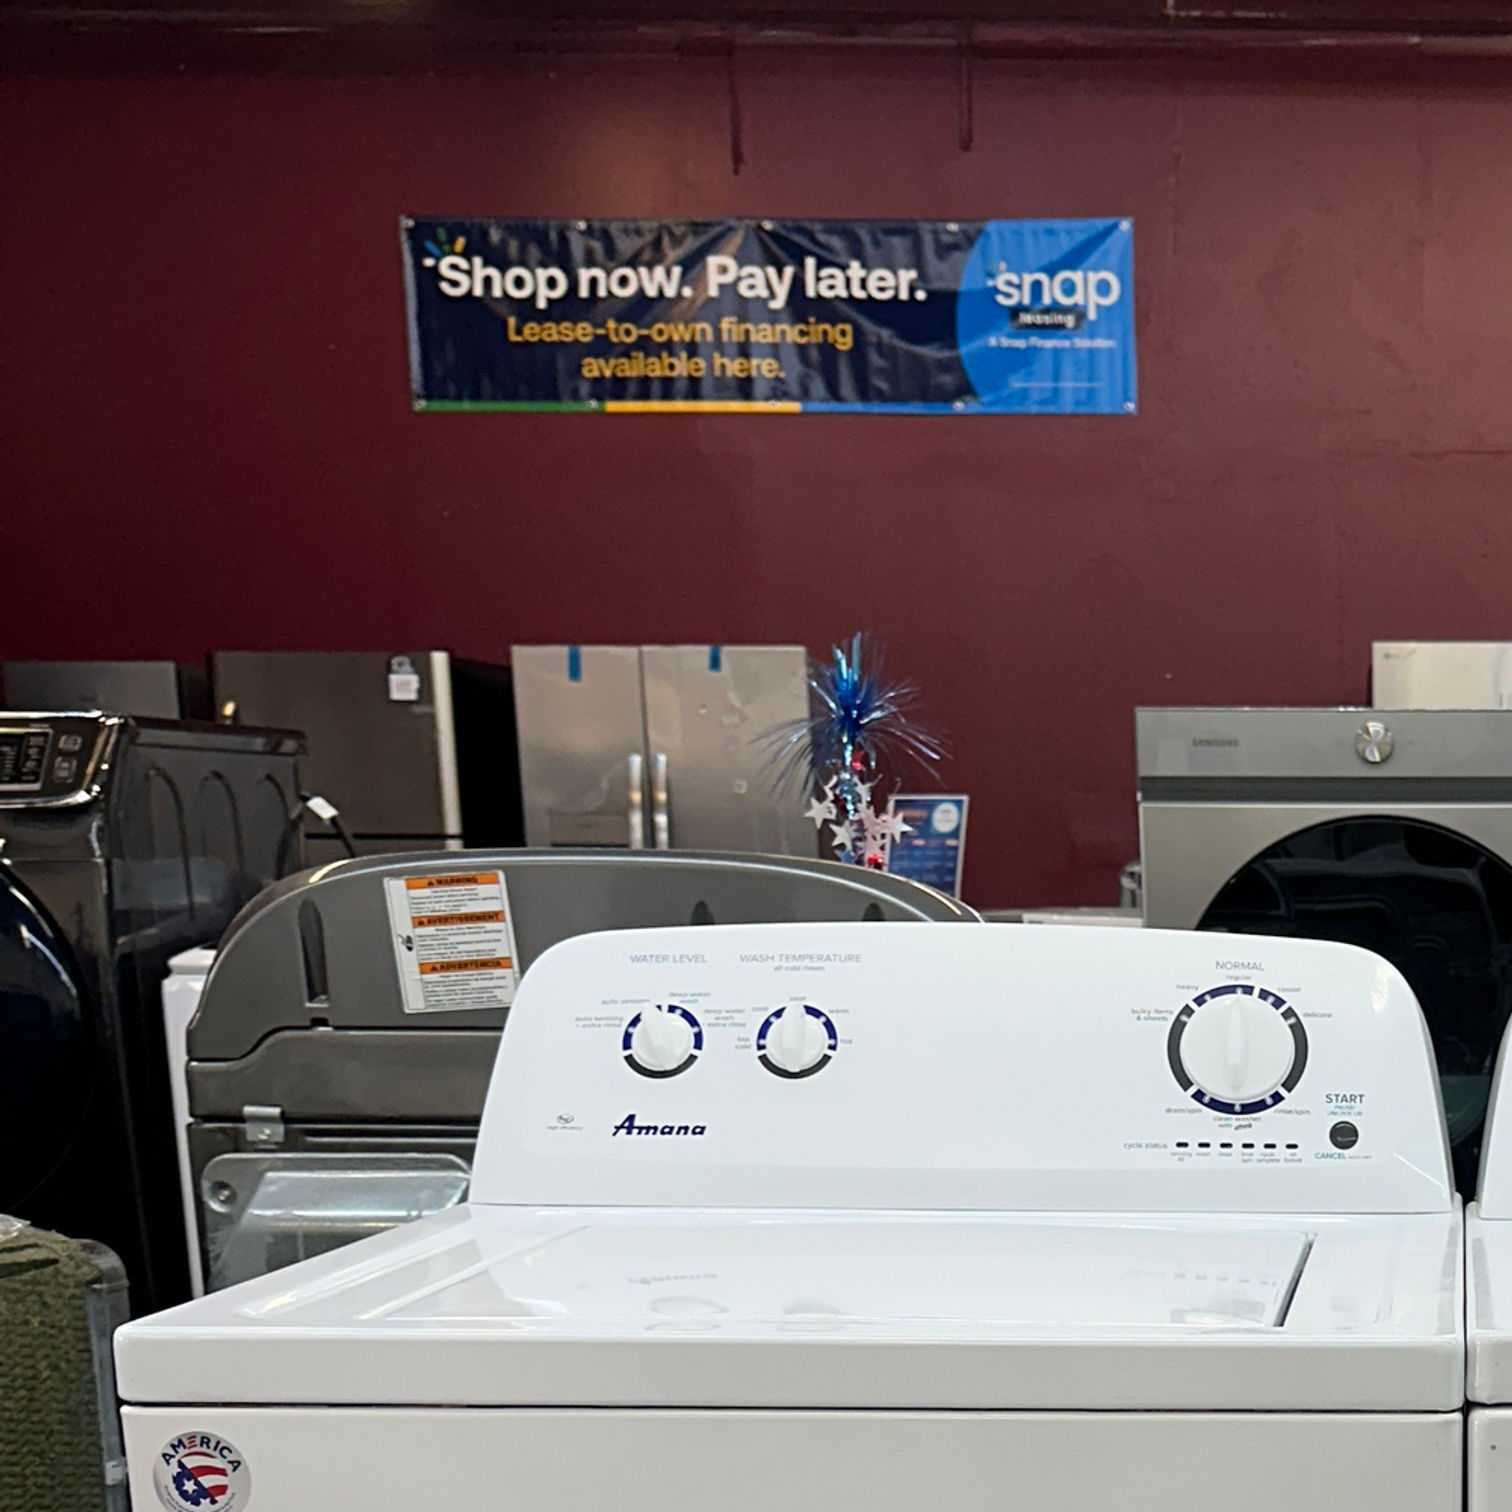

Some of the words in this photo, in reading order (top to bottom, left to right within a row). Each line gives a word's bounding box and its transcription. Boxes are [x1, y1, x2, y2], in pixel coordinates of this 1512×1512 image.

[437, 255, 569, 310] Shop
[577, 264, 693, 299] now.
[706, 255, 795, 310] Pay
[804, 256, 928, 301] later.
[994, 269, 1121, 322] snap
[507, 316, 713, 344] Lease-to-own
[719, 316, 854, 351] financing
[581, 351, 706, 379] available
[712, 351, 787, 379] here.
[630, 954, 669, 964] WATER
[672, 954, 707, 964] LEVEL
[739, 954, 775, 964] WASH
[778, 953, 863, 964] TEMPERATURE
[1215, 961, 1265, 972] NORMAL
[1325, 1093, 1365, 1104] START
[612, 1113, 707, 1137] Amana
[161, 1435, 242, 1473] AMERICA
